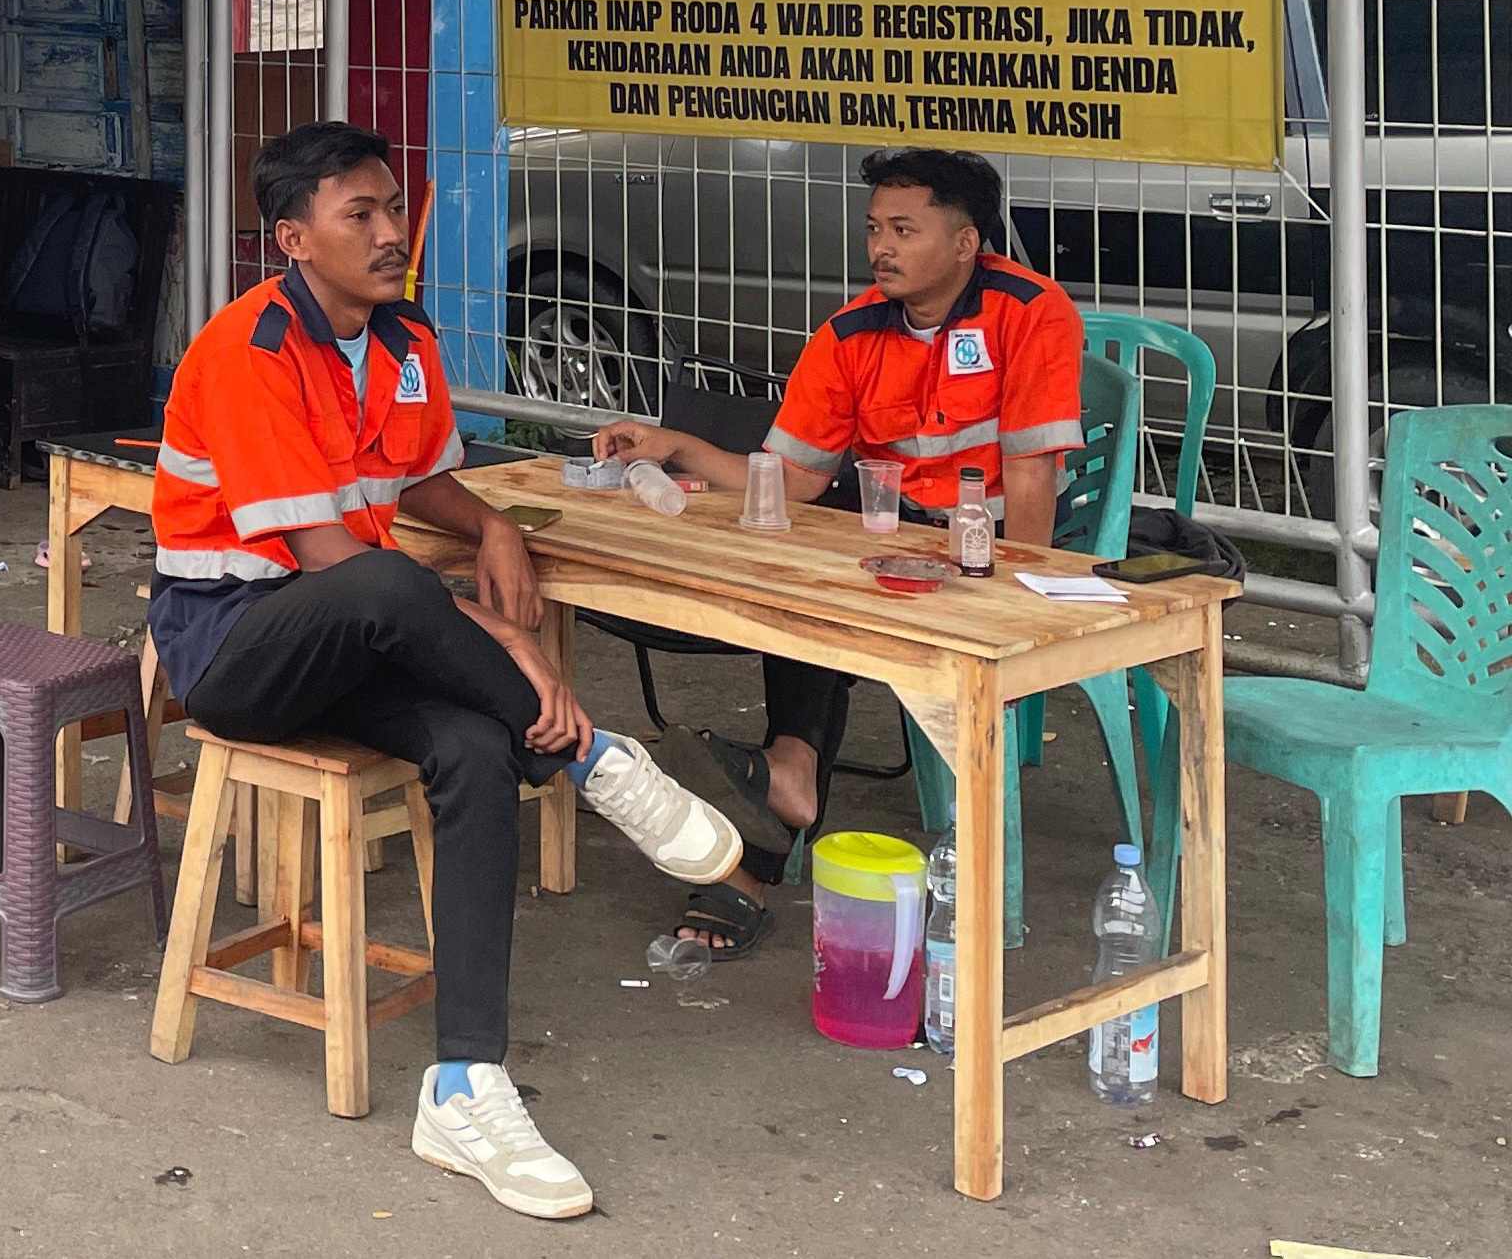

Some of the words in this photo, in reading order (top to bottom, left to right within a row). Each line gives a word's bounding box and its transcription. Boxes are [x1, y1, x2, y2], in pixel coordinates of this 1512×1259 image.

[606, 0, 662, 32] INAP
[671, 1, 740, 35] RODA
[750, 2, 767, 35] 4
[776, 3, 863, 38] WAJIB
[873, 4, 1054, 46] REGISTRASI,
[1066, 8, 1133, 46] JIKA
[1144, 9, 1255, 53] TIDAK,
[568, 40, 711, 76] KENDARAAN
[720, 45, 791, 80] ANDA
[800, 47, 874, 83] AKAN
[884, 49, 913, 84] DI
[923, 50, 1060, 90] KENAKAN
[1071, 55, 1178, 95] DENDA
[610, 82, 660, 116] DAN
[668, 85, 831, 126] PENGUNCIAN
[1025, 100, 1122, 141] KASIH
